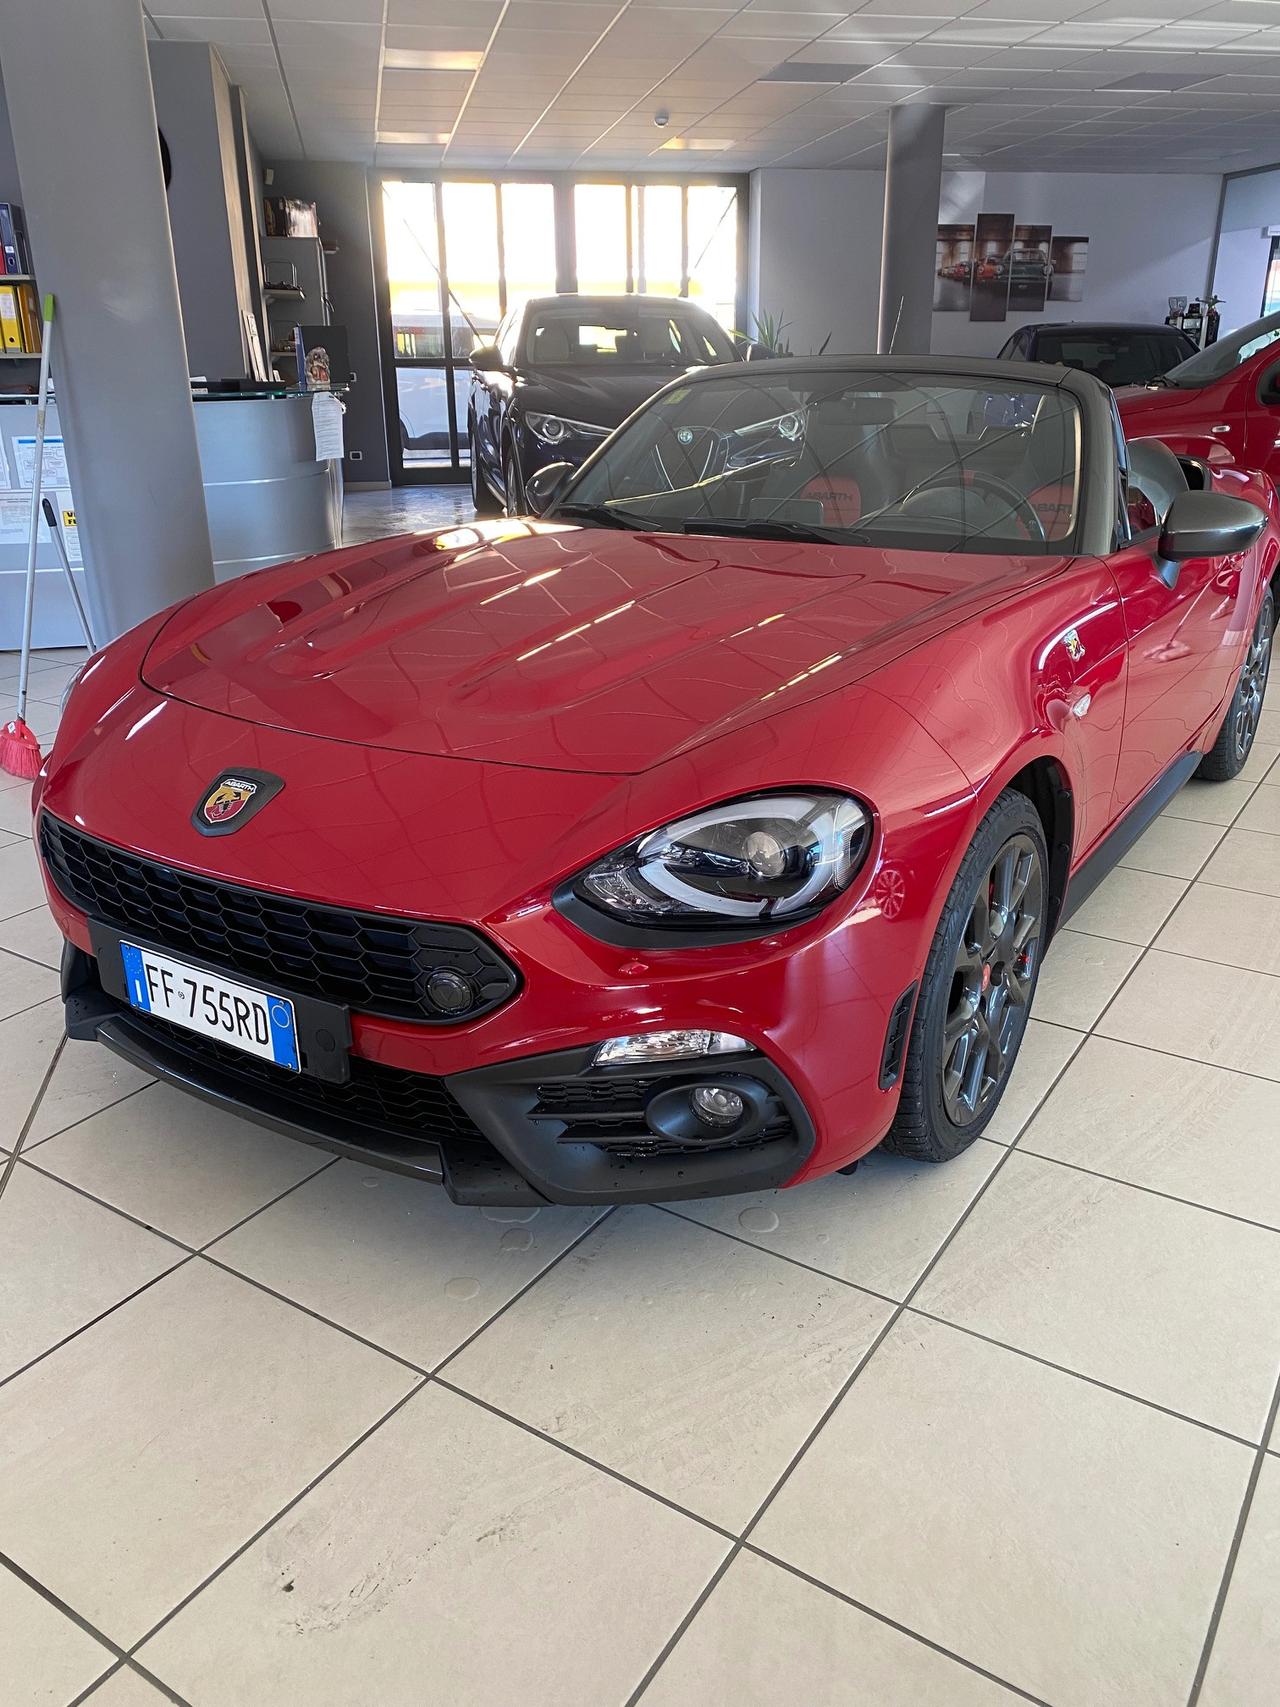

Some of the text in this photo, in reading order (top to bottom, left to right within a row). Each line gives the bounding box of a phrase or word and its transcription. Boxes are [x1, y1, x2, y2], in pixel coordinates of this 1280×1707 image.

[224, 780, 255, 792] ABARTH
[146, 963, 270, 1046] FF 755RD
